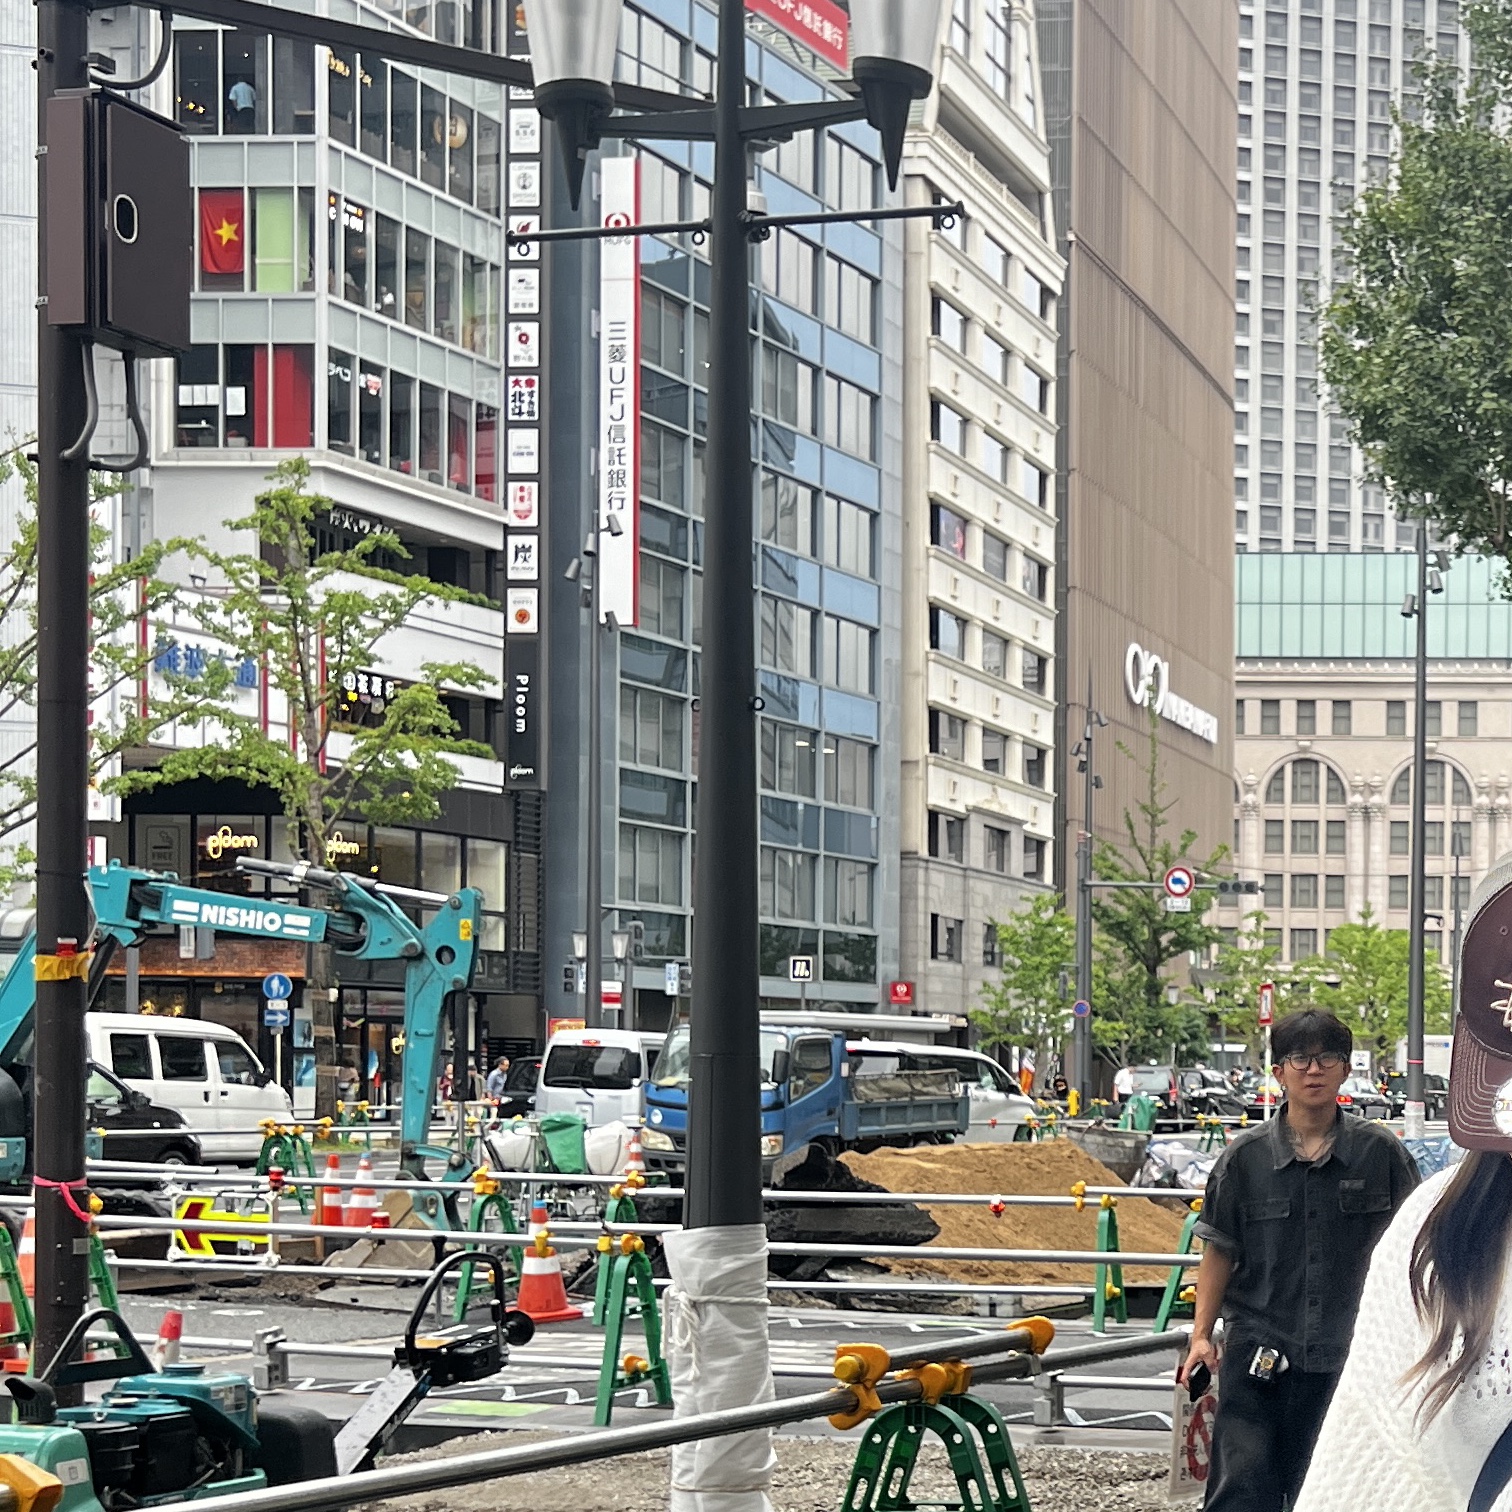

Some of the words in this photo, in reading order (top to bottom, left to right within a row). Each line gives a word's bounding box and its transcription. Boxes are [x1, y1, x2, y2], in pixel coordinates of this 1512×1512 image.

[607, 321, 627, 511] 三菱UFJ信託銀行
[515, 674, 530, 733] Ploom
[201, 904, 282, 932] NISHIO
